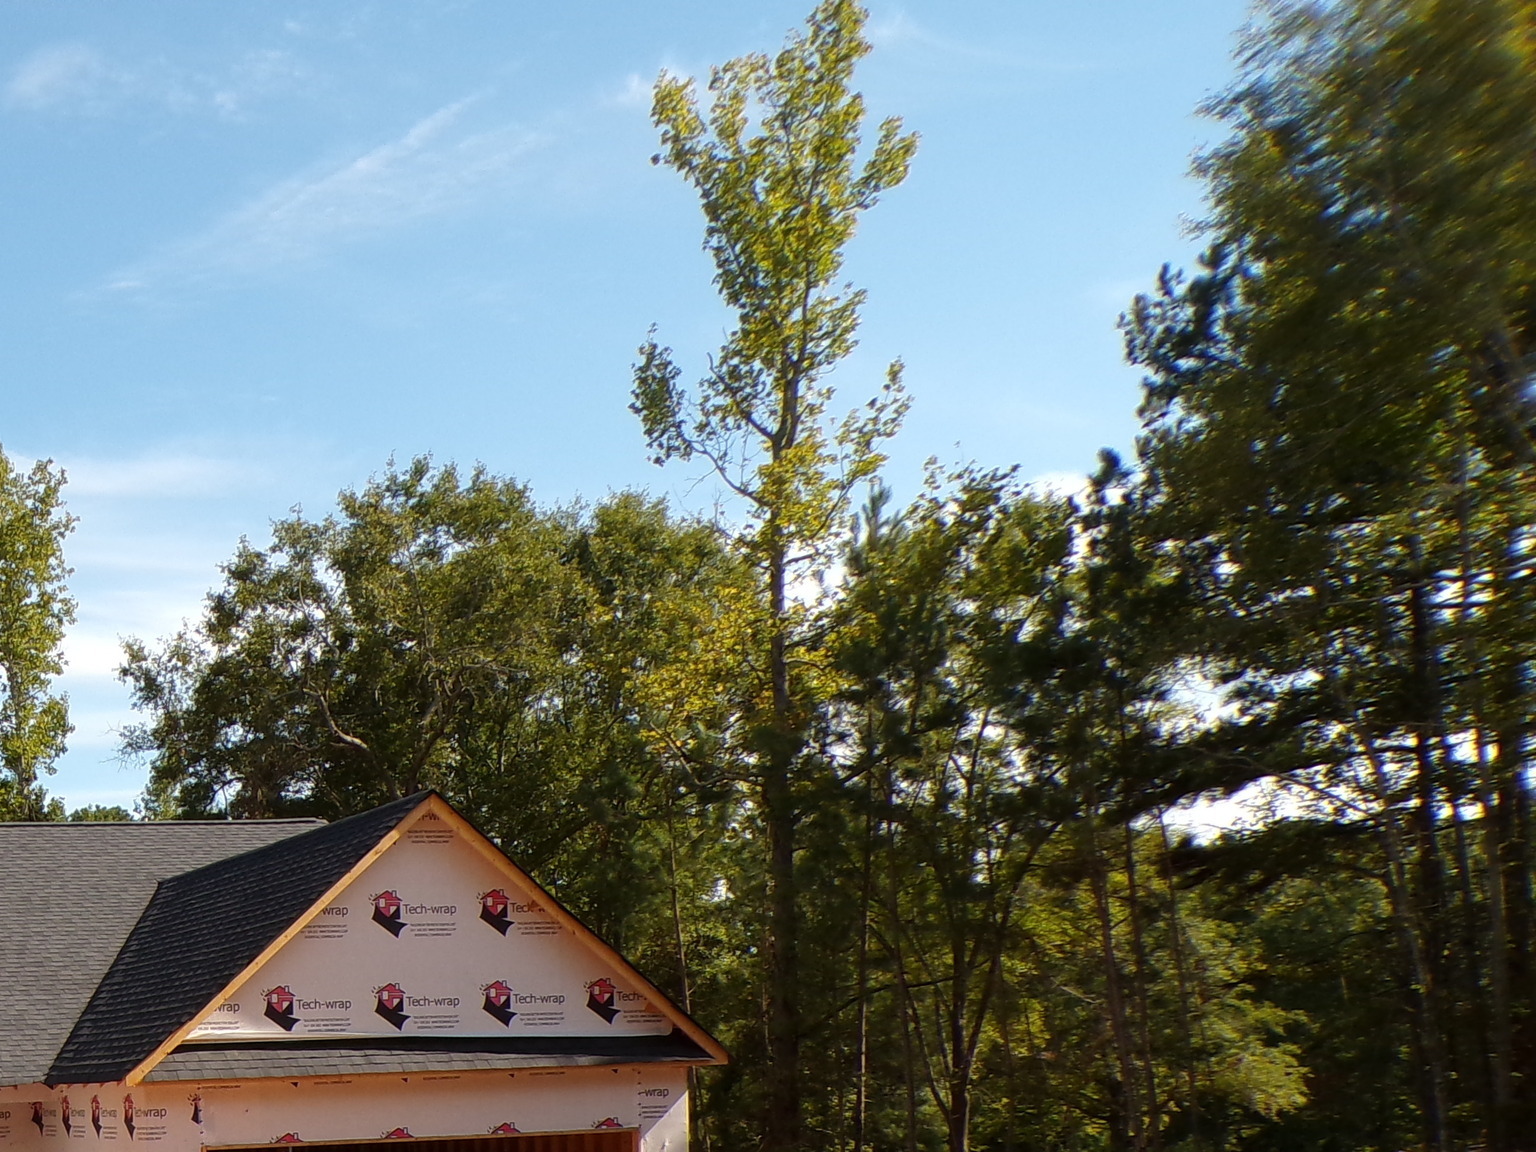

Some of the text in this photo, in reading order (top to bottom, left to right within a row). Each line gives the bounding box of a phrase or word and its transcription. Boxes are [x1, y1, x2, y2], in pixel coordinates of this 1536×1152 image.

[403, 902, 456, 916] Tech-wrap
[406, 995, 459, 1008] Tech-wrap
[513, 993, 565, 1004] Tech-wrap
[296, 999, 351, 1011] Tech-wrap
